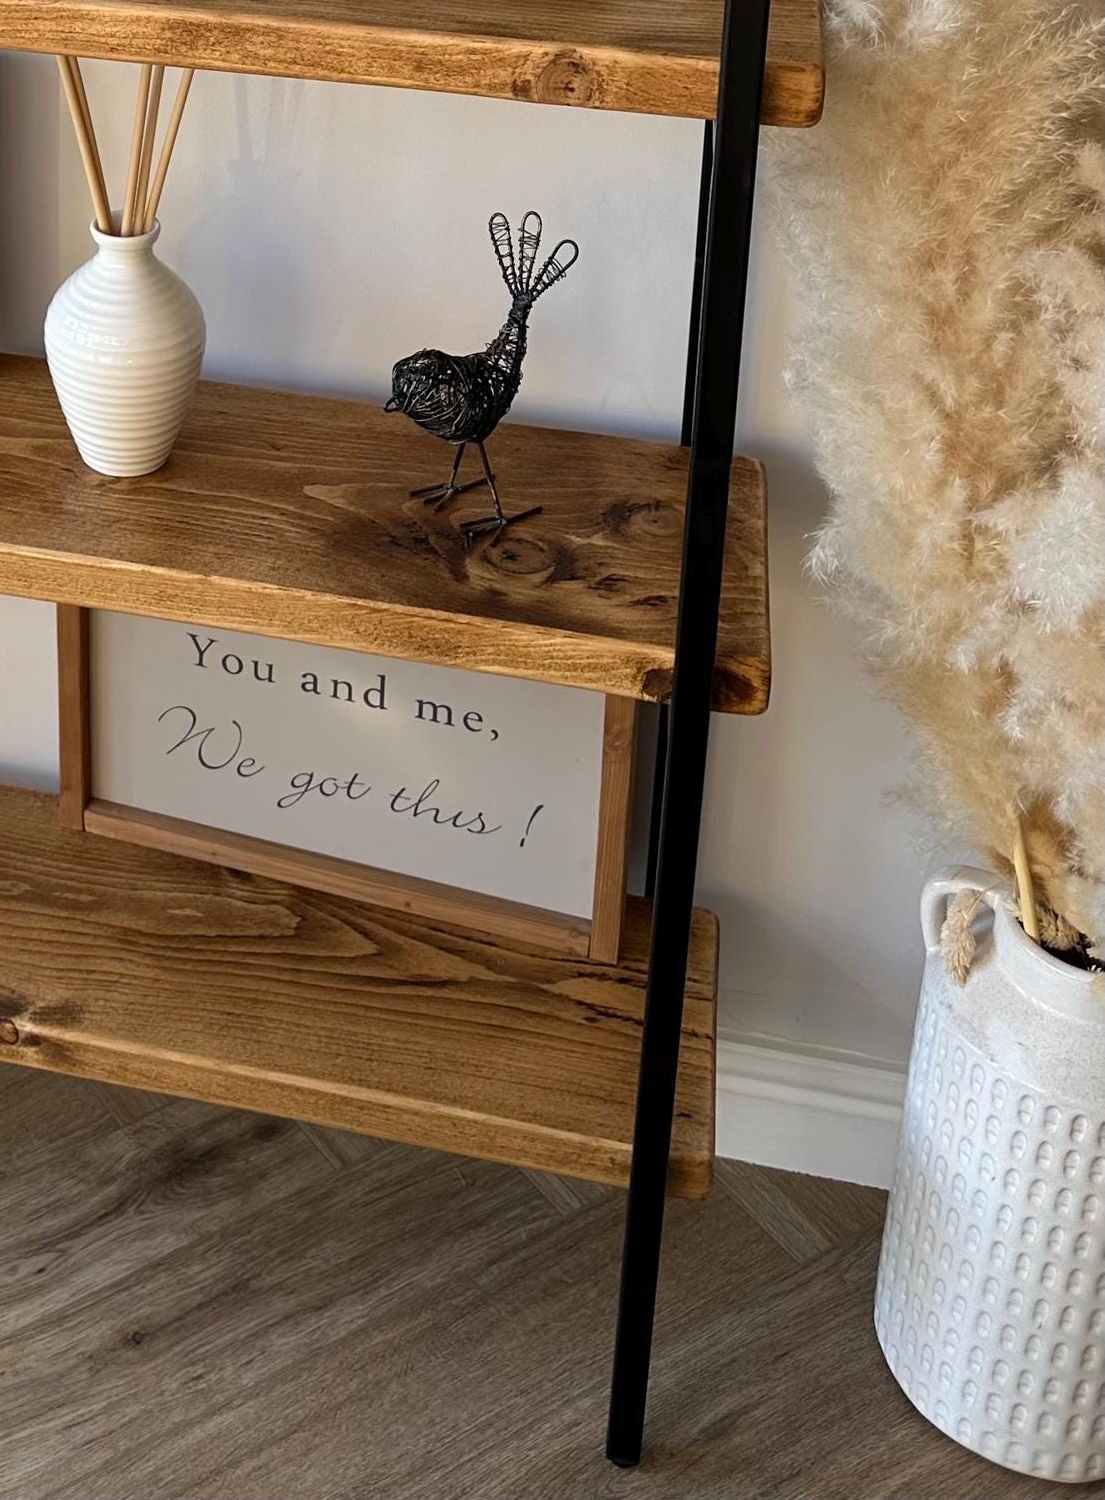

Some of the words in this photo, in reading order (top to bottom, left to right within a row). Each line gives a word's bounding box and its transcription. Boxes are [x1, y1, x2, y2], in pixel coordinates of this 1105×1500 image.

[185, 631, 277, 684] You
[300, 673, 389, 711] and
[414, 699, 501, 742] me,
[157, 705, 266, 778] We
[276, 771, 373, 809] got
[389, 778, 503, 835] this
